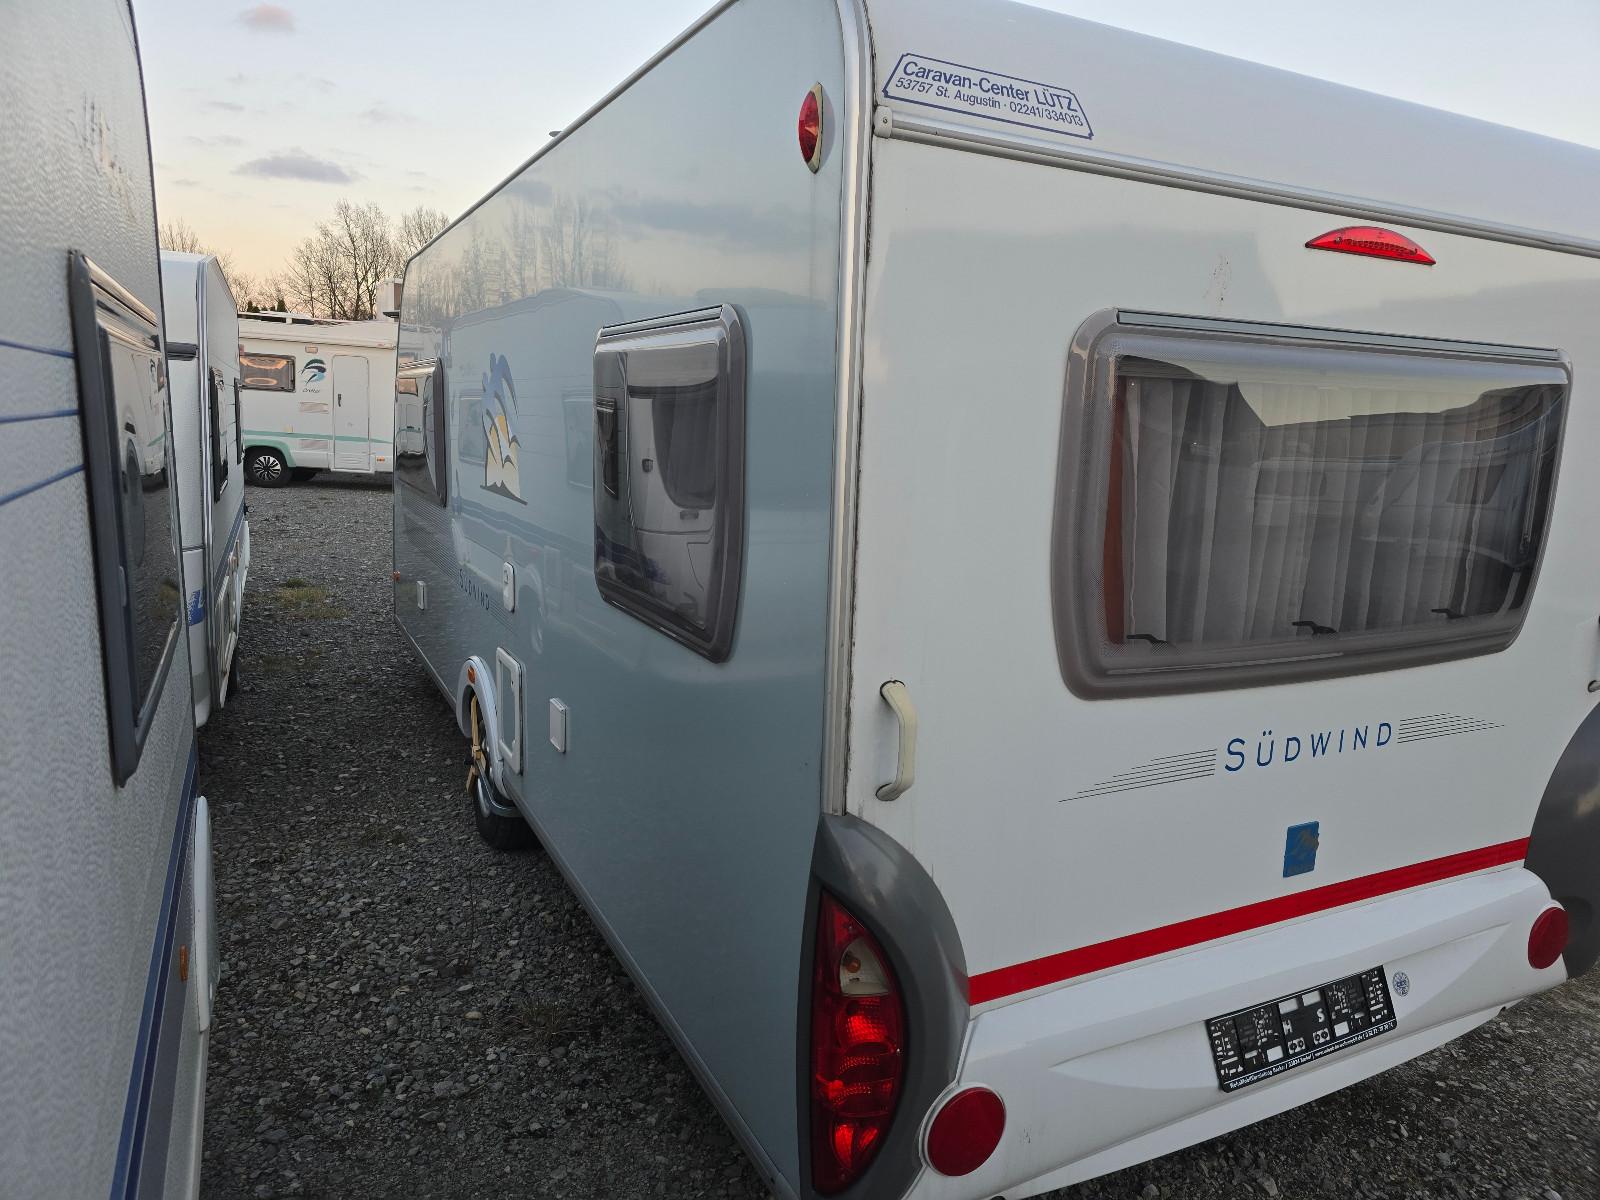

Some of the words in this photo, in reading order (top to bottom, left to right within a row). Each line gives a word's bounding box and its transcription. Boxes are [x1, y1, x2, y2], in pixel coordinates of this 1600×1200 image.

[895, 77, 933, 94] 53757
[935, 86, 950, 98] St.
[954, 90, 1001, 109] Augustin
[1009, 102, 1084, 127] 02241/334013
[903, 61, 1030, 102] Caravan-Center
[1034, 88, 1078, 112] LÜTZ
[1224, 722, 1392, 771] SÜDWIND
